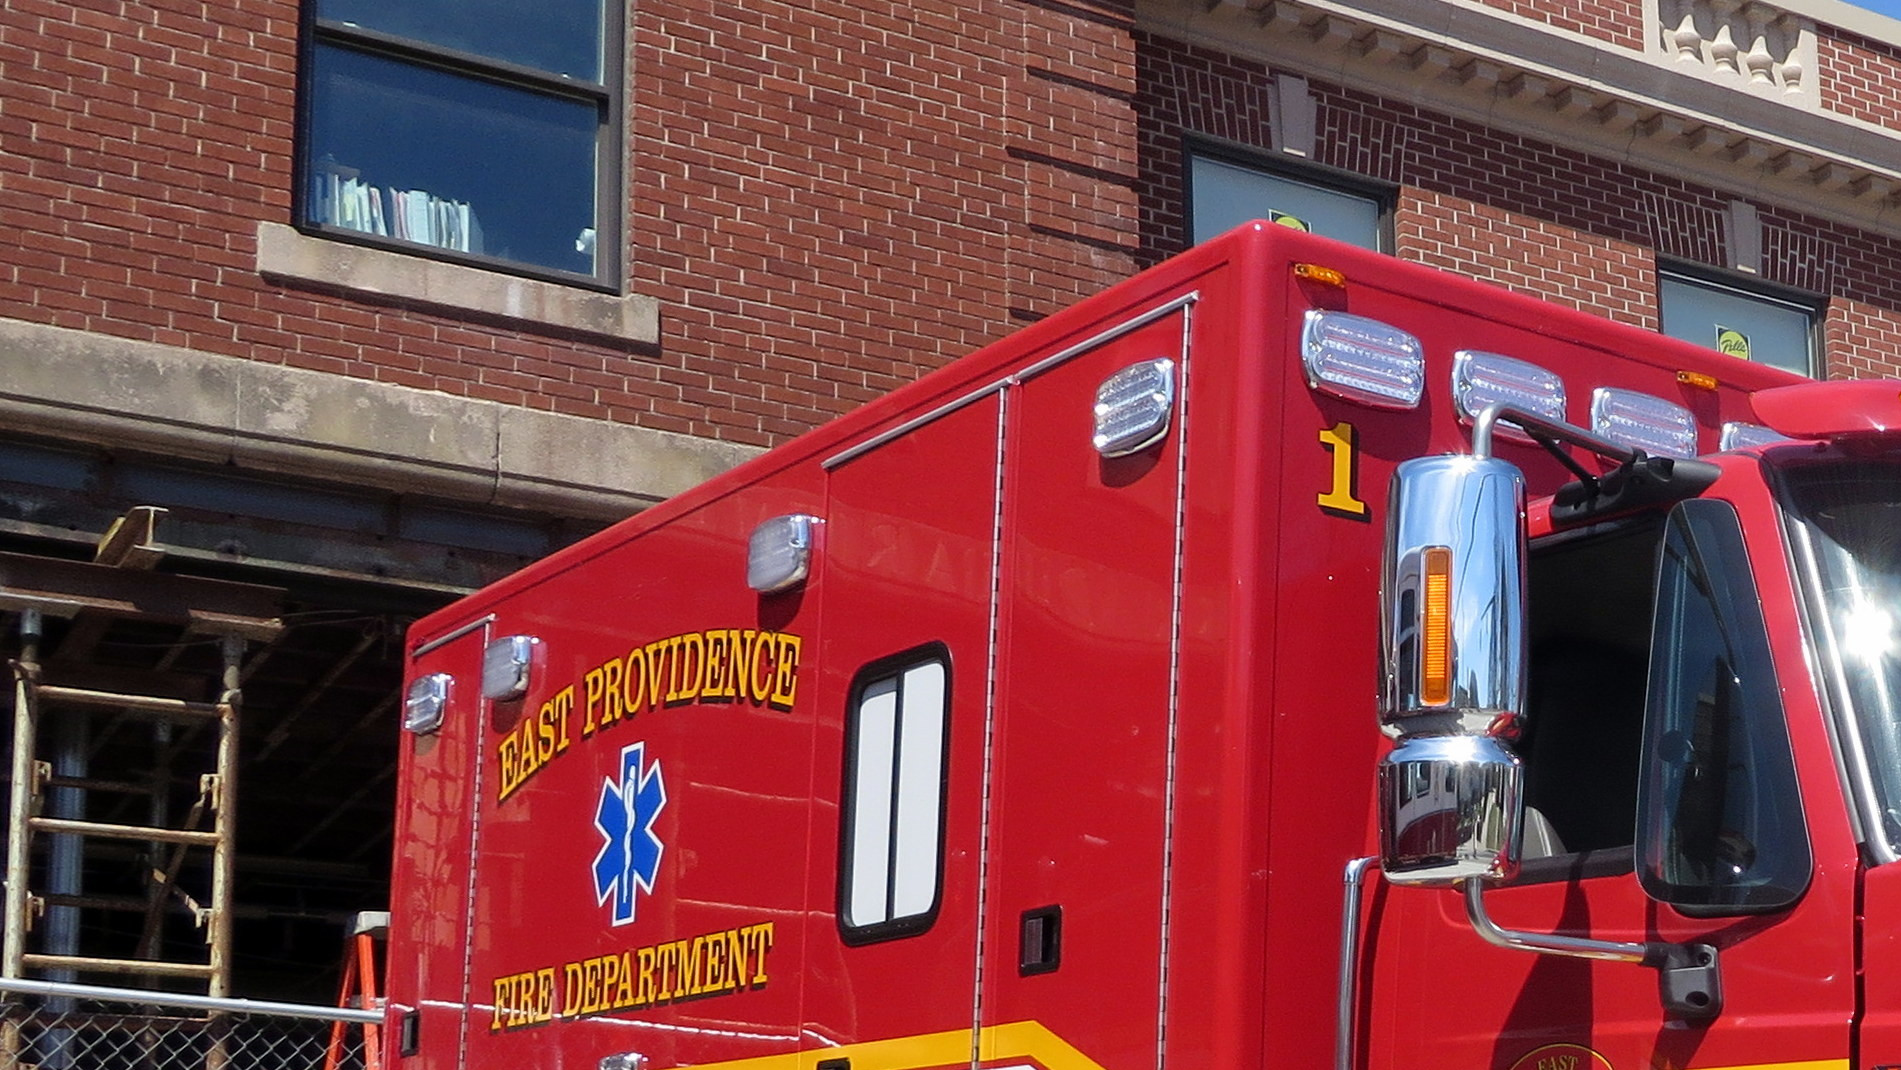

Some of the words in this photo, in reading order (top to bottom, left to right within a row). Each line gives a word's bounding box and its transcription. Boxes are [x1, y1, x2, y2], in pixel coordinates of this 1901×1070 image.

[1317, 422, 1364, 514] 1
[498, 687, 573, 802] EAST
[580, 628, 801, 737] PROVIDENCE
[490, 965, 555, 1033] FIRE
[562, 922, 774, 1020] DEPARTMENT
